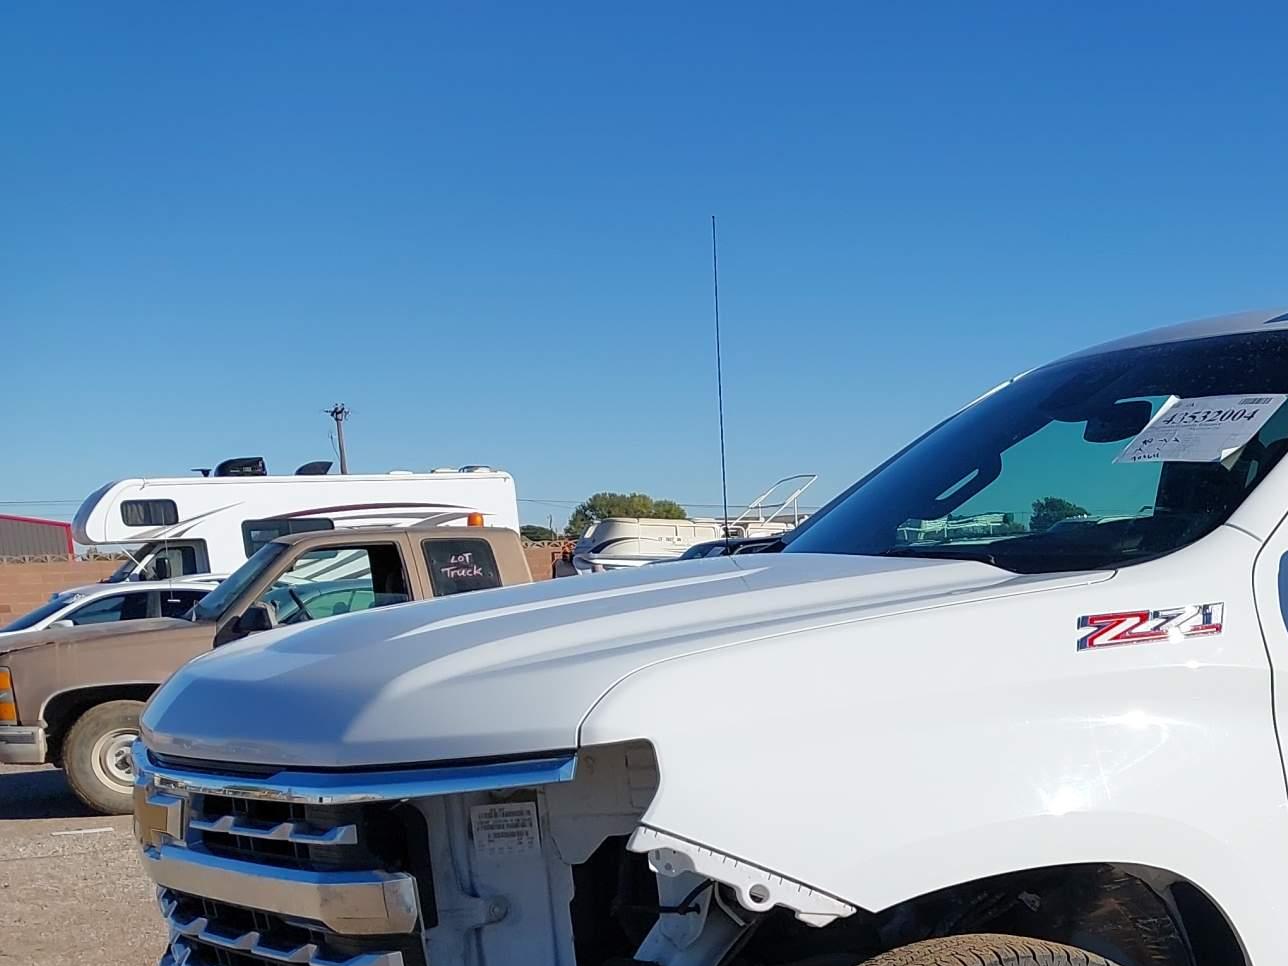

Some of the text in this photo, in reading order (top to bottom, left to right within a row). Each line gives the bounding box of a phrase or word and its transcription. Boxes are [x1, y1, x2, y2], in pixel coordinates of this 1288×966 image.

[1162, 407, 1260, 426] 43532004
[450, 552, 472, 564] LOT
[441, 564, 483, 578] Truck
[1077, 601, 1225, 652] Z71
